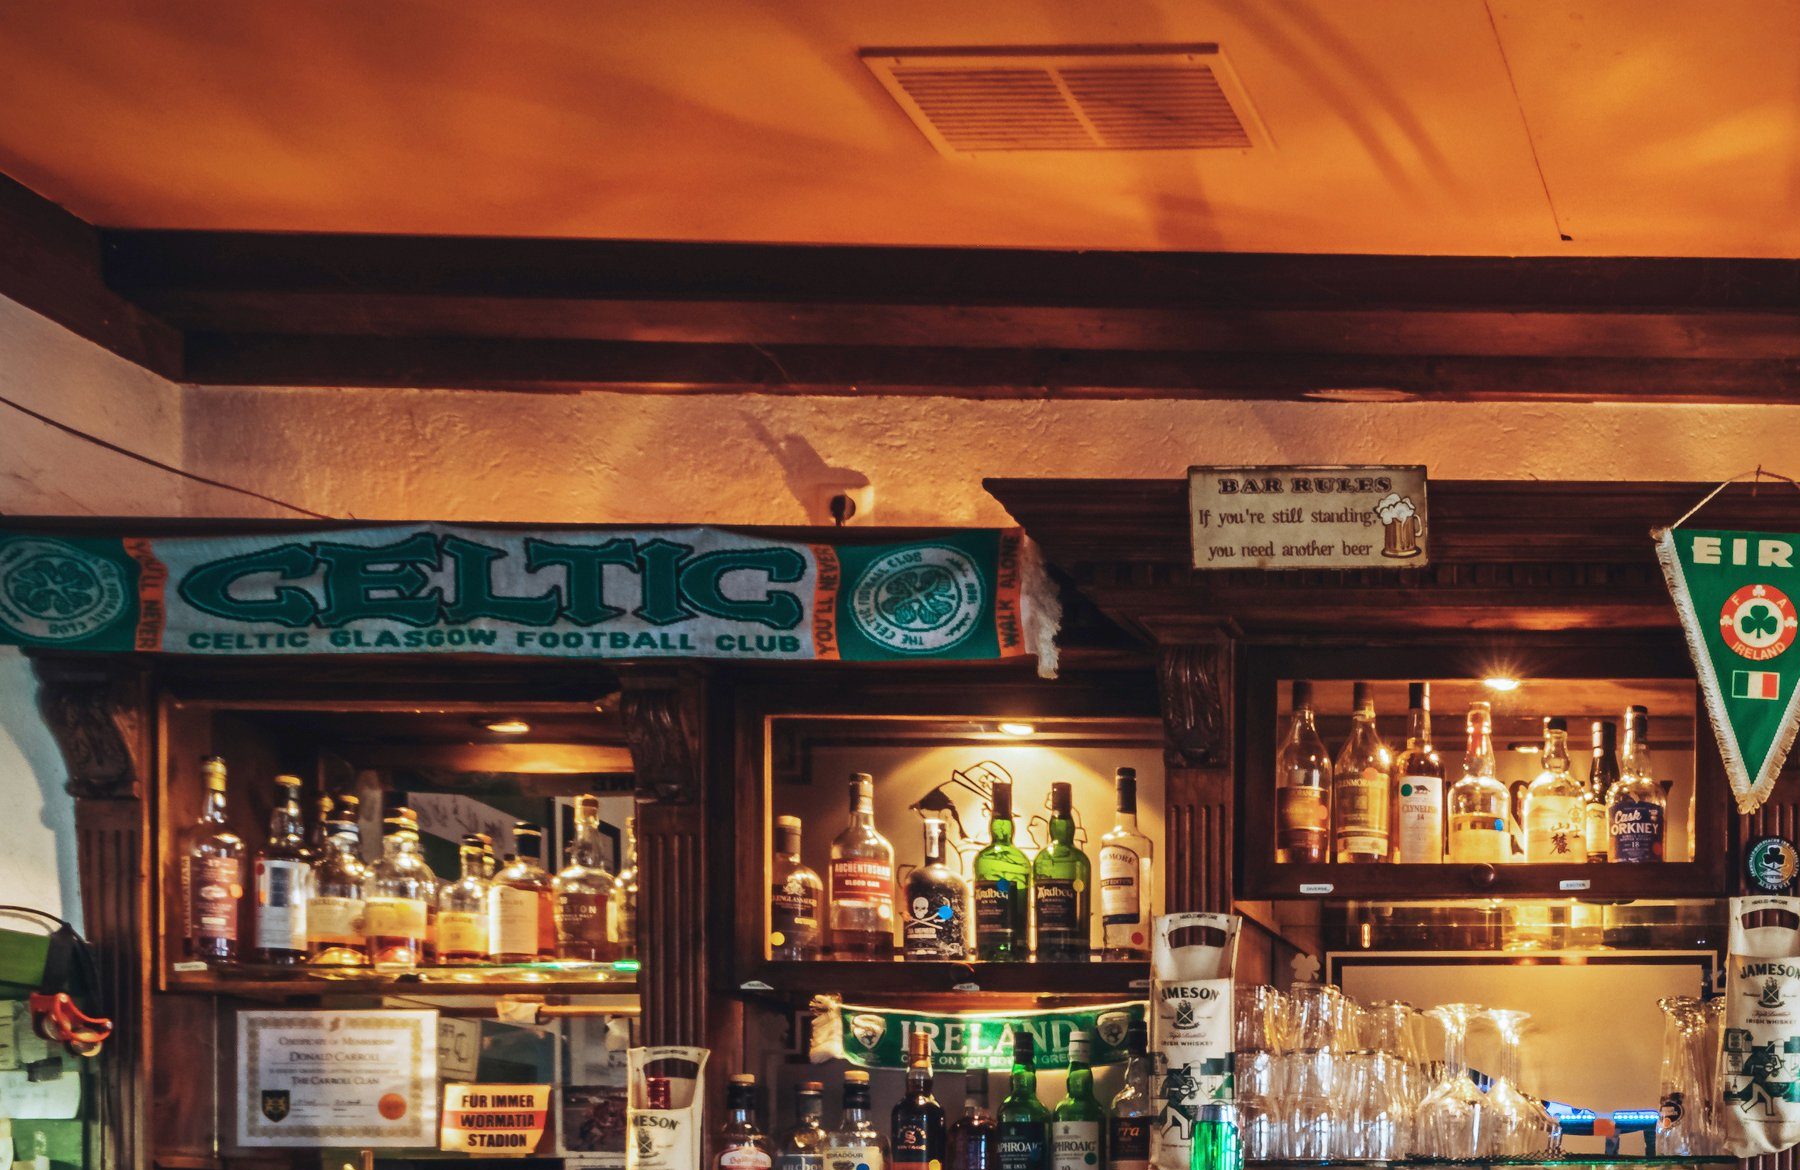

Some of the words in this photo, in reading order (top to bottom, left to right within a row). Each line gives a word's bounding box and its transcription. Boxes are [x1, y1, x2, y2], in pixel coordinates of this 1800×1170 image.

[1218, 477, 1284, 494] BAR
[1291, 477, 1392, 494] RULES
[1199, 509, 1211, 525] If
[1217, 509, 1265, 528] you're
[1272, 508, 1303, 523] still
[1208, 545, 1235, 561] you
[1241, 541, 1275, 557] need
[1282, 540, 1335, 557] another
[1342, 541, 1373, 556] beer
[178, 532, 806, 631] CELTIC
[137, 600, 160, 649] NEVER
[818, 596, 836, 655] YOU'LL
[1000, 601, 1020, 647] WALK
[187, 631, 309, 649] CELTIC
[329, 628, 498, 648] GLASGOW
[516, 629, 696, 651] FOOTBALL
[715, 634, 800, 652] CLUB
[1731, 641, 1787, 661] IRELAND
[1614, 809, 1642, 825] Cask
[1610, 822, 1660, 836] ORKNEY
[939, 1055, 957, 1065] ON
[960, 1056, 987, 1067] YOU
[491, 1094, 535, 1109] IMMER
[459, 1113, 536, 1130] WORMATIA
[467, 1132, 528, 1148] STADION
